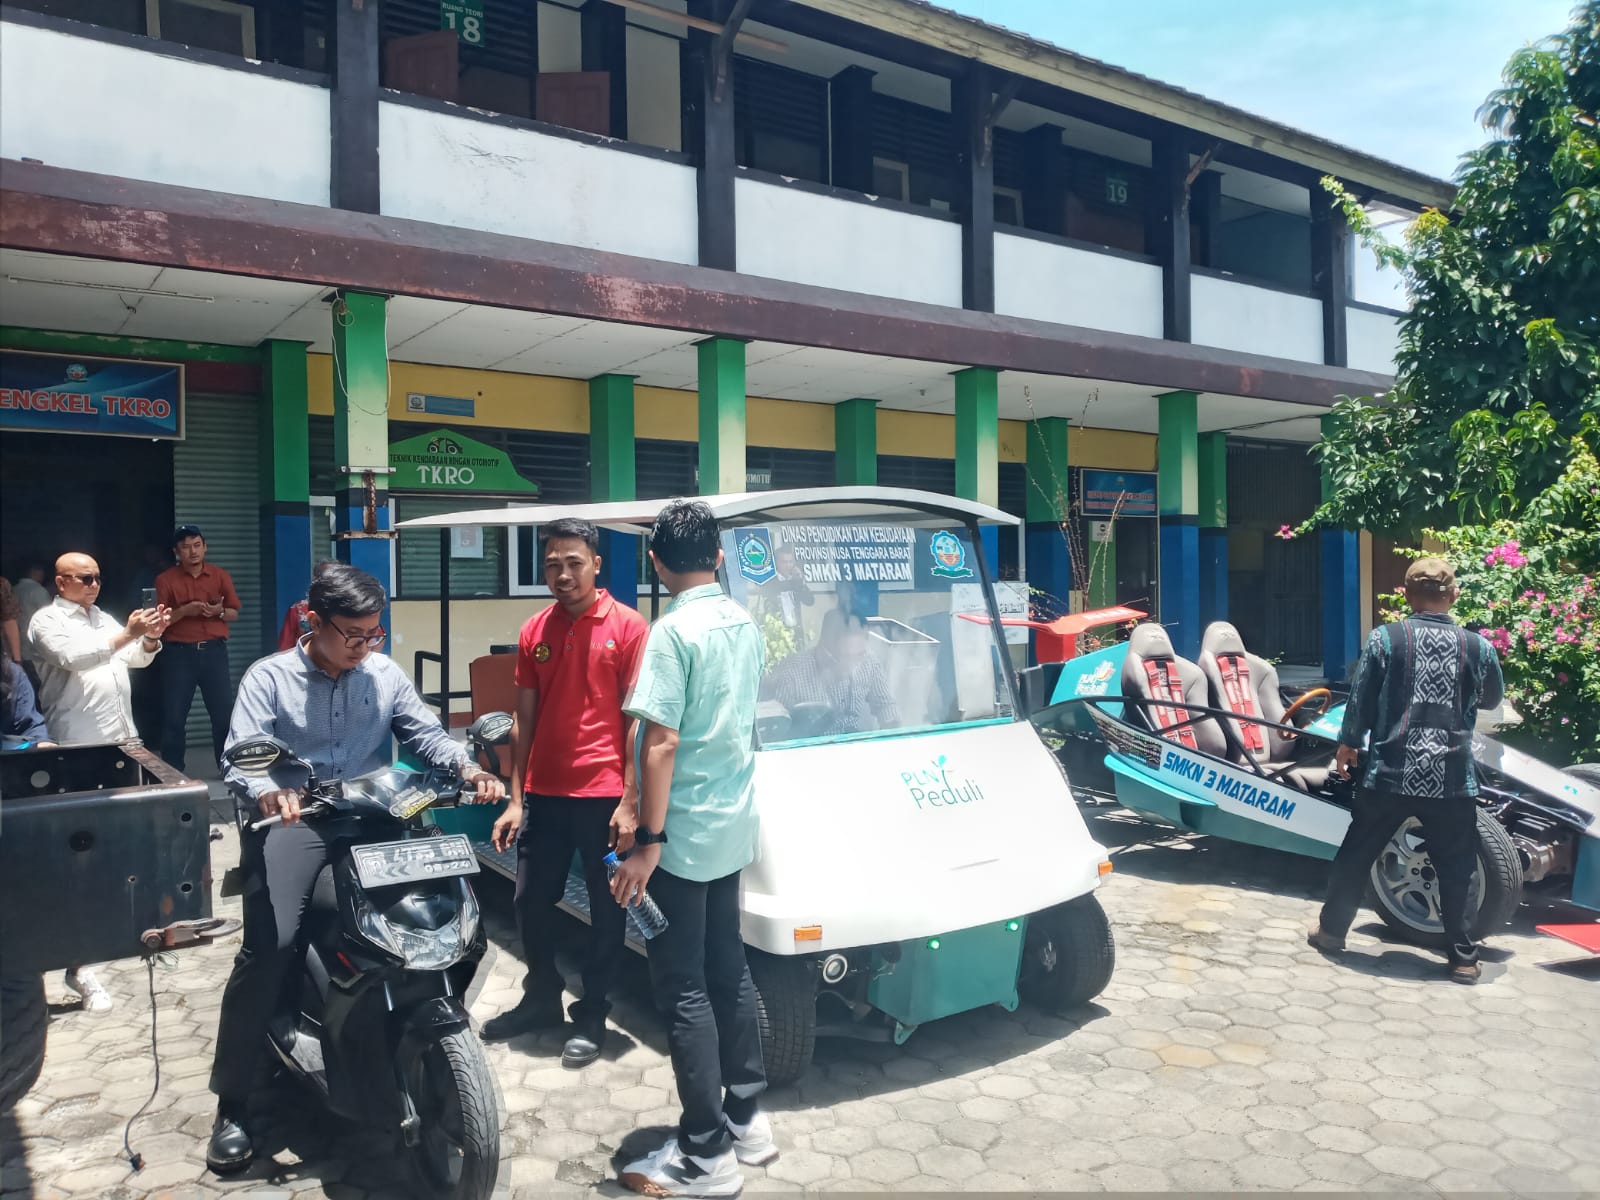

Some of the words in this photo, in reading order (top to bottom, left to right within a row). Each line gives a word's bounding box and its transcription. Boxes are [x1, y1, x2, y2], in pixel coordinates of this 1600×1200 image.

[445, 12, 481, 43] 18
[1110, 184, 1128, 203] 19
[0, 388, 98, 415] ENGKEL
[102, 396, 171, 418] TKRO
[416, 465, 475, 485] TKRO
[781, 526, 807, 543] DINAS
[807, 526, 852, 543] PENDIDIKAN
[853, 526, 870, 543] DAN
[870, 527, 917, 543] KEBUDAYAAN
[794, 546, 830, 560] PROVINSI
[831, 546, 850, 560] NUSA
[850, 547, 889, 560] TENGGARA
[889, 547, 912, 560] BARAT
[803, 563, 842, 582] SMKN
[843, 563, 853, 581] 3
[853, 563, 913, 581] MATARAM
[910, 769, 985, 810] Peduli
[1162, 751, 1206, 782] SMKN
[1203, 770, 1218, 789] 3
[1216, 775, 1297, 820] MATARAM
